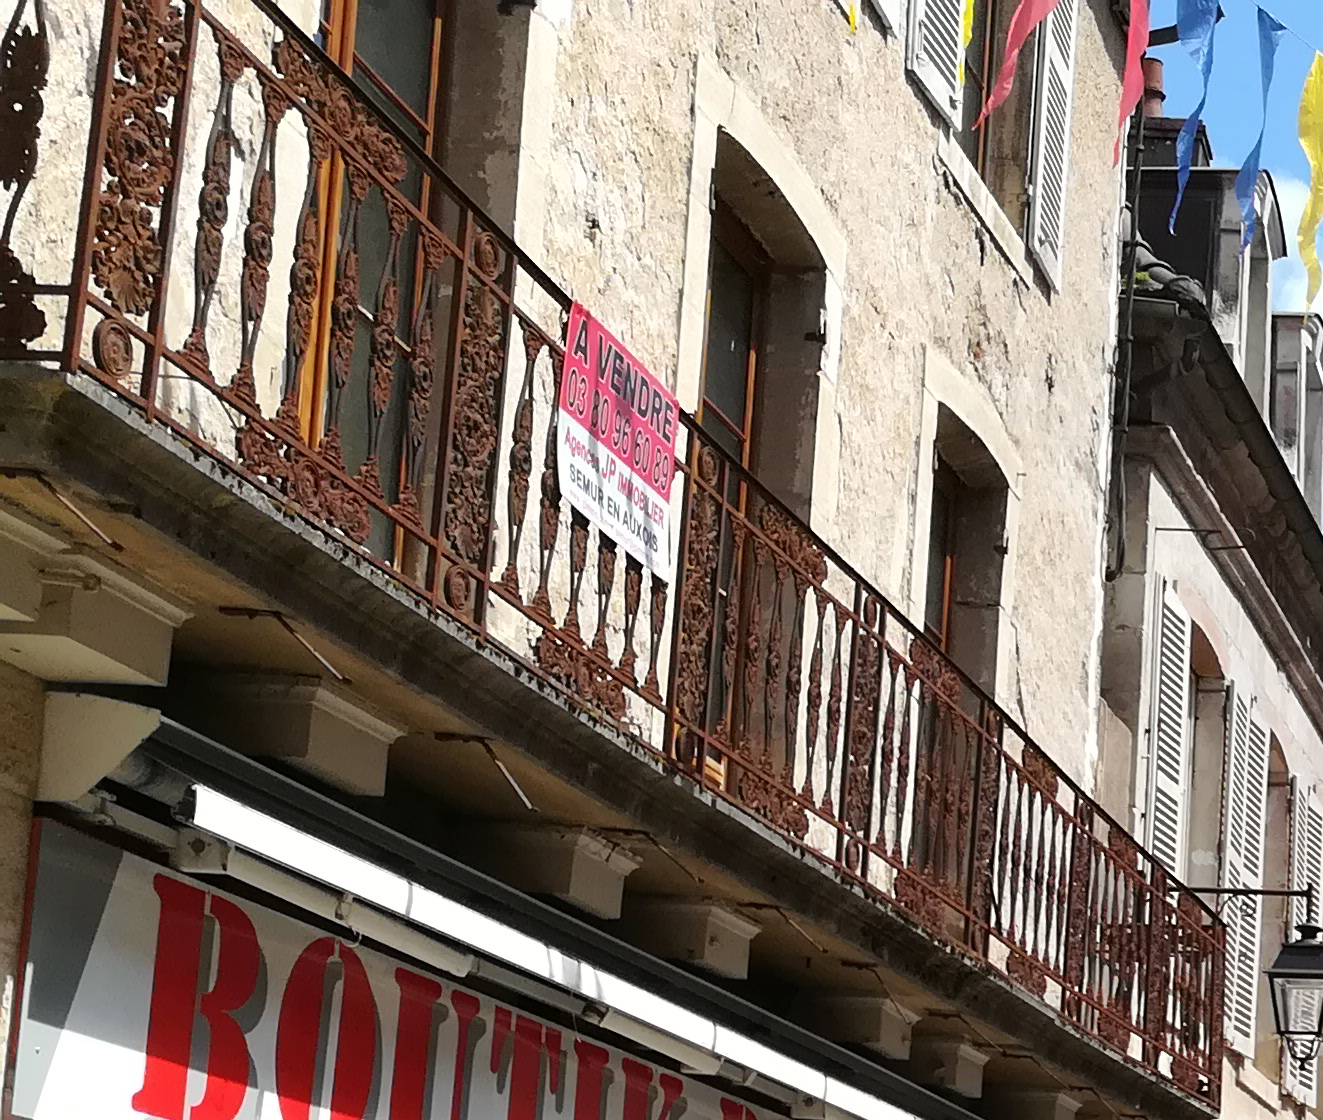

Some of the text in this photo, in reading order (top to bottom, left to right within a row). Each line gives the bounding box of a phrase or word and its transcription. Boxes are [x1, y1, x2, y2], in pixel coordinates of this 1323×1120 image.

[566, 368, 670, 493] 03 80 96 60 89
[572, 317, 674, 447] A VENDRE
[569, 462, 605, 510] SEMUR
[607, 495, 620, 522] EN
[622, 510, 659, 553] AUXOIS
[601, 453, 617, 484] JP
[617, 470, 665, 530] IMMOBILIER
